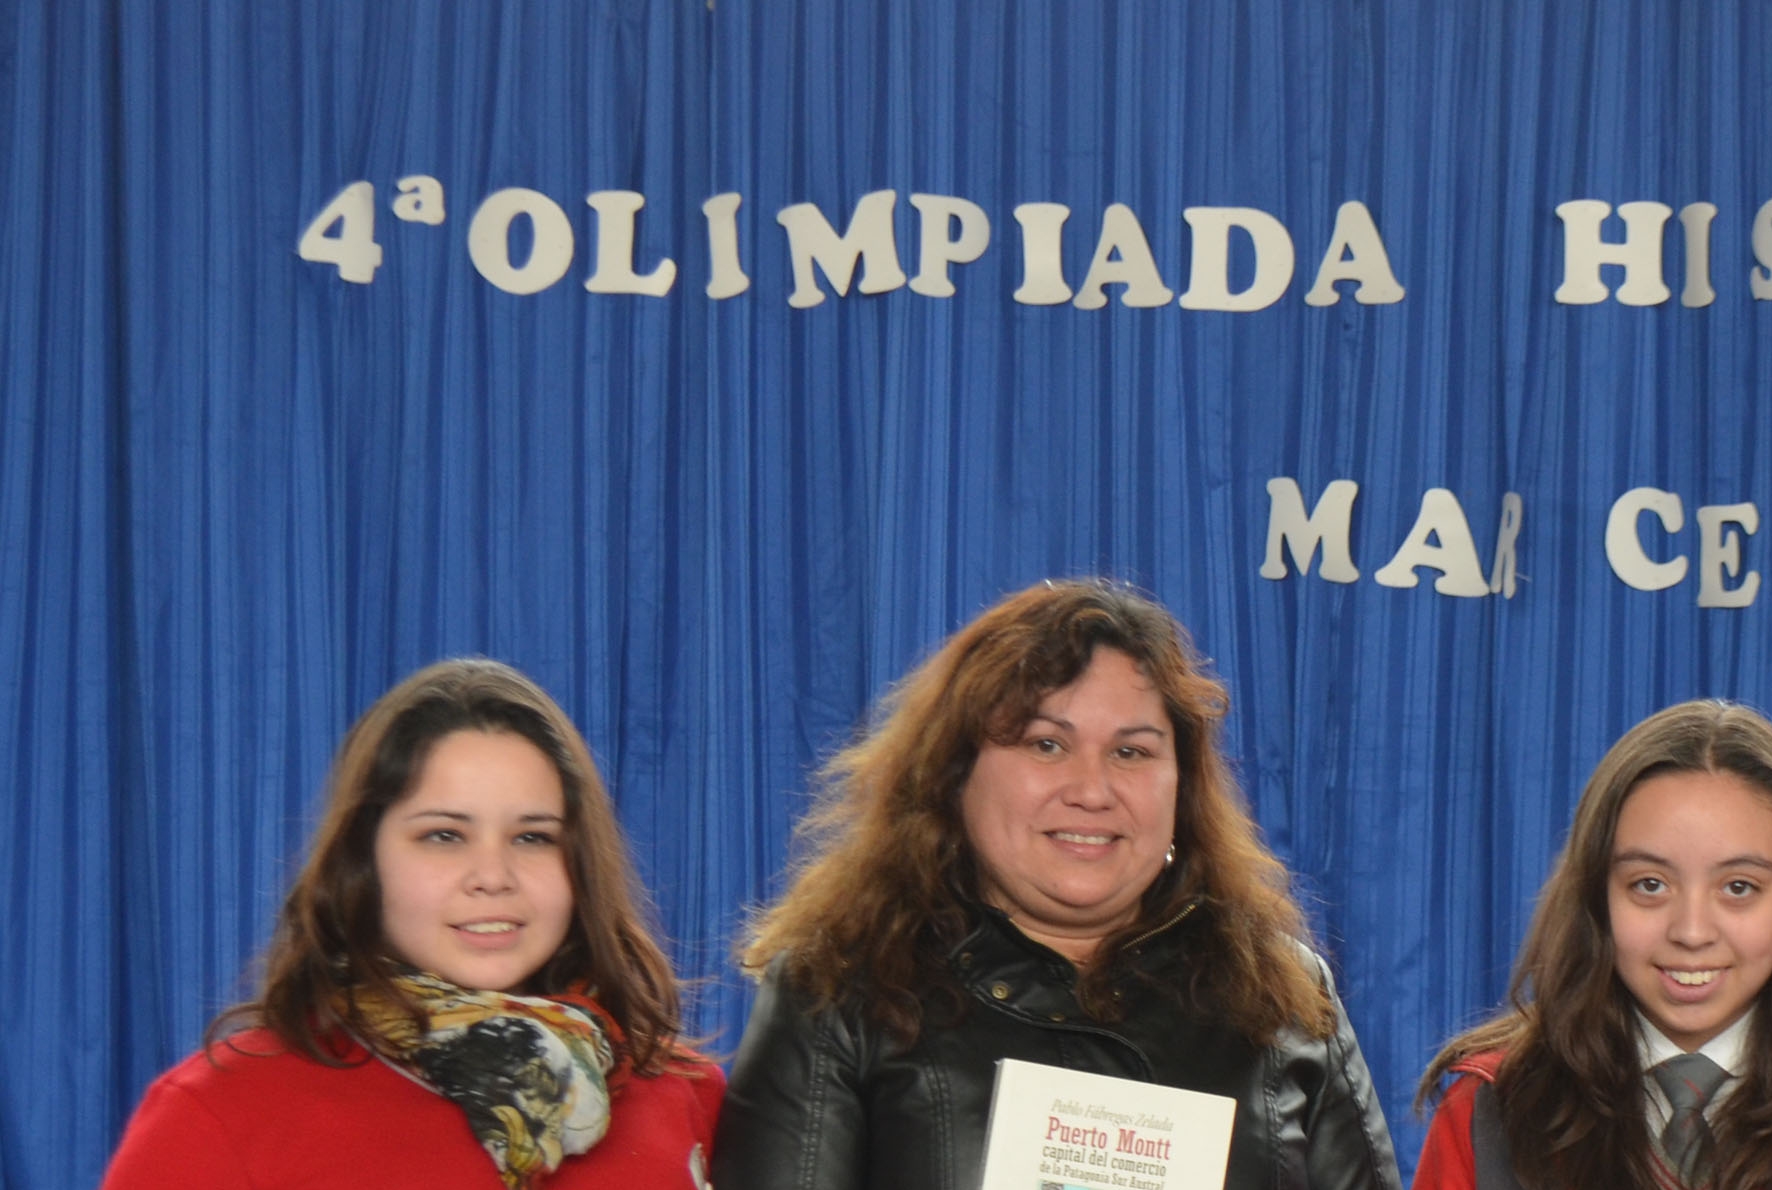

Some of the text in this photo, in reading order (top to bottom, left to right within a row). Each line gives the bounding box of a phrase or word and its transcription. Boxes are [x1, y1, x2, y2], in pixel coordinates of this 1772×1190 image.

[467, 188, 1406, 313] OLIMPIADA
[1045, 1115, 1172, 1161] Puerto Montt
[1039, 1161, 1051, 1173] de
[1052, 1163, 1061, 1176] la
[1042, 1145, 1167, 1177] capital del comercio
